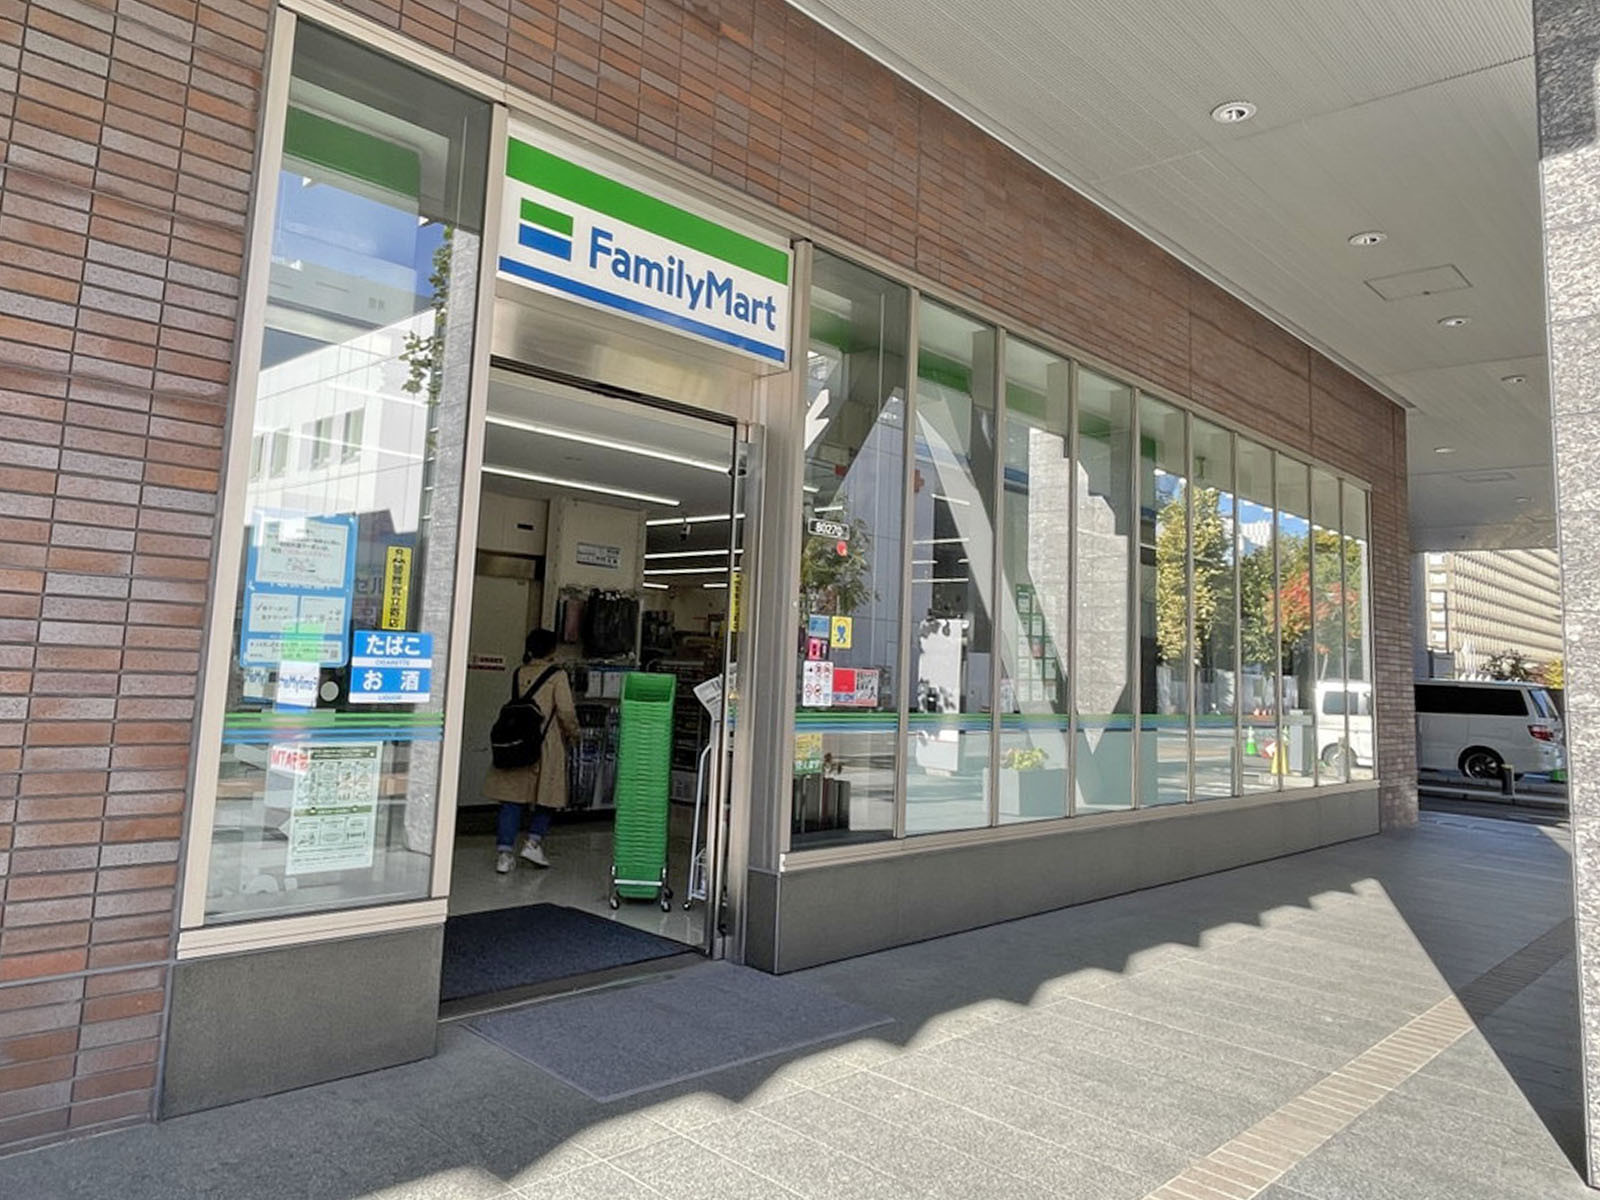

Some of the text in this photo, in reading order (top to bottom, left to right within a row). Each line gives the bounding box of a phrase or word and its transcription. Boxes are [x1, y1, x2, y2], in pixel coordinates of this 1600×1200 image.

[589, 226, 776, 331] FamilyMart
[366, 634, 421, 656] たばこ
